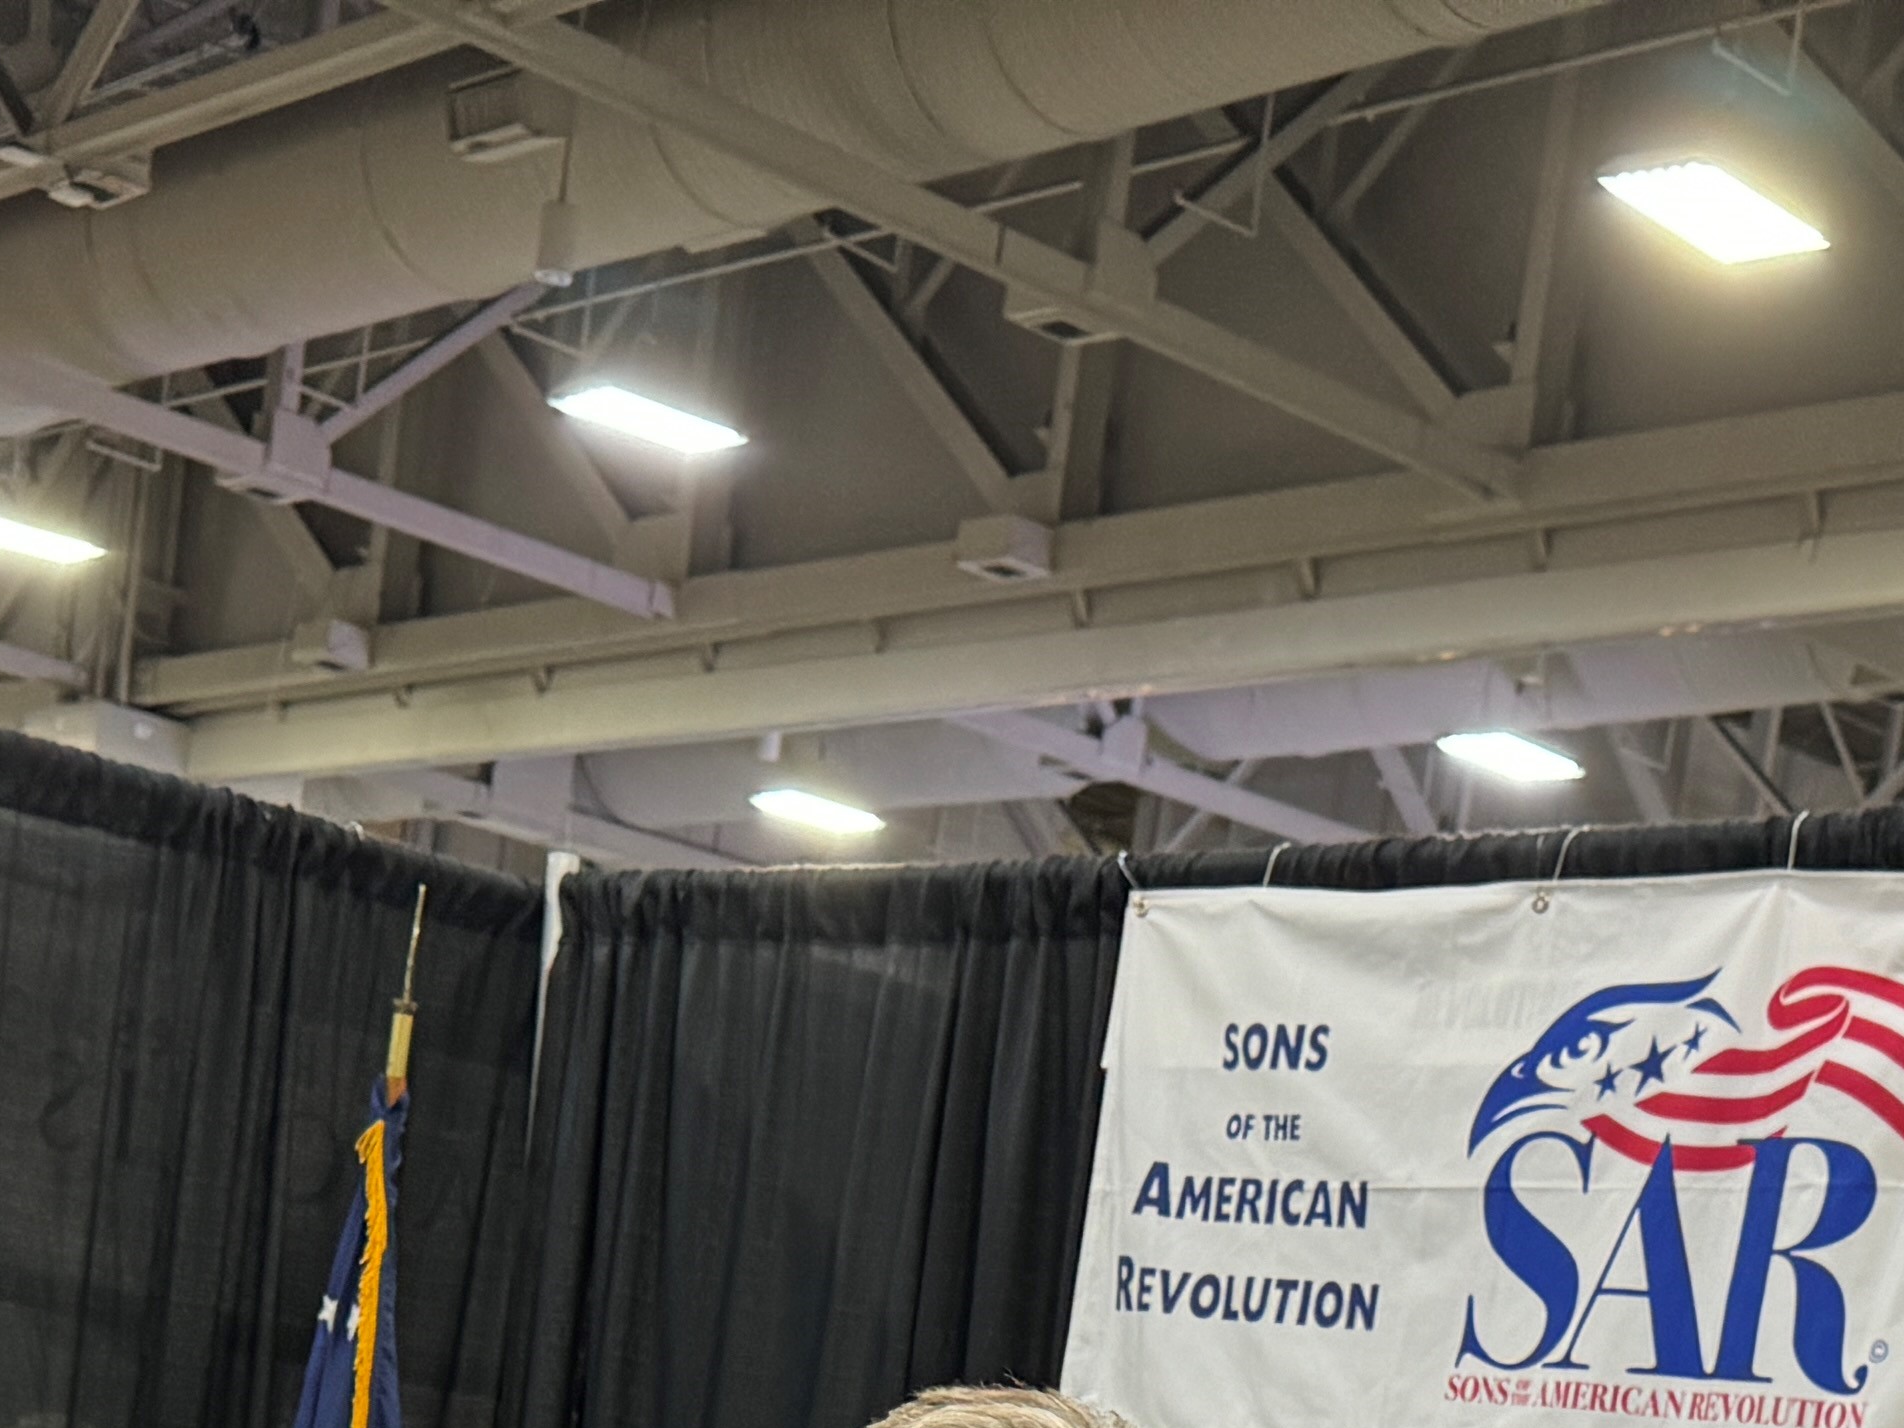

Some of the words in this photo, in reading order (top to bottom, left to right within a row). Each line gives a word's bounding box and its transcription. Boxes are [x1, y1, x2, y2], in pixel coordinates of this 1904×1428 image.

[1222, 1023, 1330, 1072] SONS
[1226, 1114, 1255, 1140] OF
[1263, 1114, 1301, 1141] THE
[1132, 1161, 1368, 1229] AMERICAN
[1116, 1255, 1380, 1331] REVOLUTION
[1455, 1132, 1879, 1396] SAR
[1444, 1374, 1509, 1406] SONS
[1531, 1381, 1687, 1422] AMERICAN
